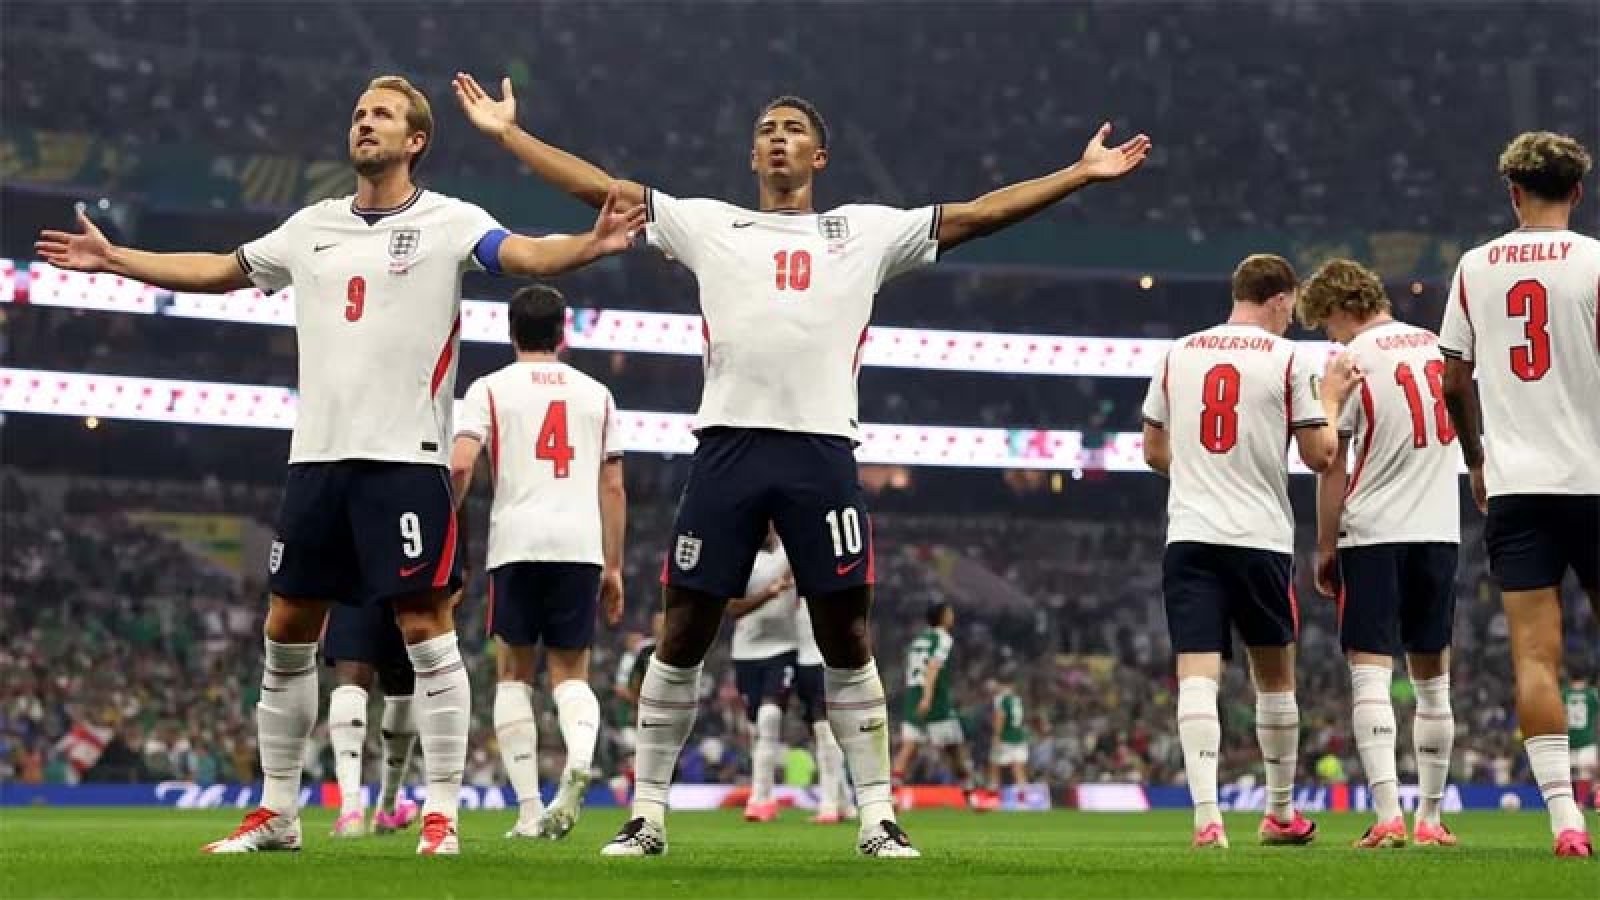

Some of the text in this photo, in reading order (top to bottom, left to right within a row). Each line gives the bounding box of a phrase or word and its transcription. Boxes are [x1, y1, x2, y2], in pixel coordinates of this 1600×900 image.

[773, 249, 811, 291] 10
[1488, 241, 1572, 264] O'REILLY
[345, 275, 366, 322] 9
[1184, 335, 1274, 352] ANDERSON
[1506, 279, 1551, 381] 3
[531, 371, 568, 385] RICE
[1200, 363, 1241, 454] 8
[1394, 359, 1456, 448] 18
[535, 400, 575, 479] 4
[400, 511, 423, 558] 9
[825, 506, 863, 557] 10
